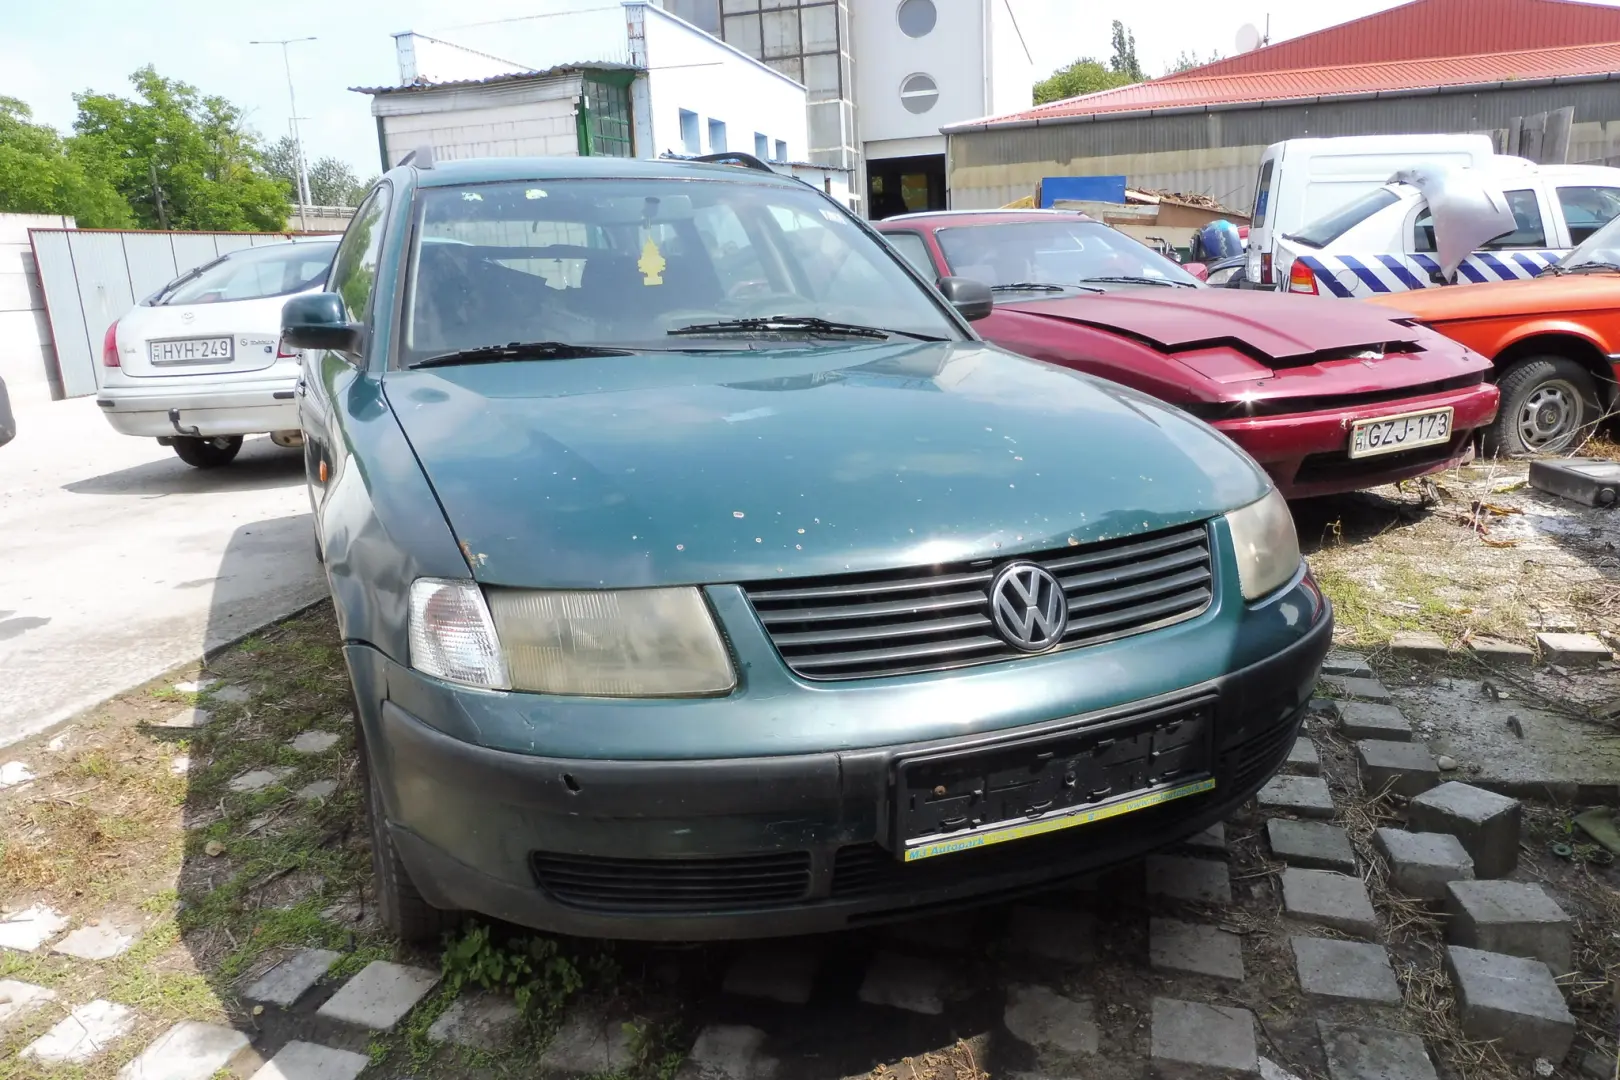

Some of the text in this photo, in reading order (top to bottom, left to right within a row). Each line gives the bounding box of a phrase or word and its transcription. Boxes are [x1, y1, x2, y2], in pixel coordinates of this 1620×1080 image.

[163, 340, 229, 360] HYH-249
[1368, 413, 1448, 448] GZJ-173
[993, 565, 1067, 650] VW
[931, 837, 985, 856] Autopark
